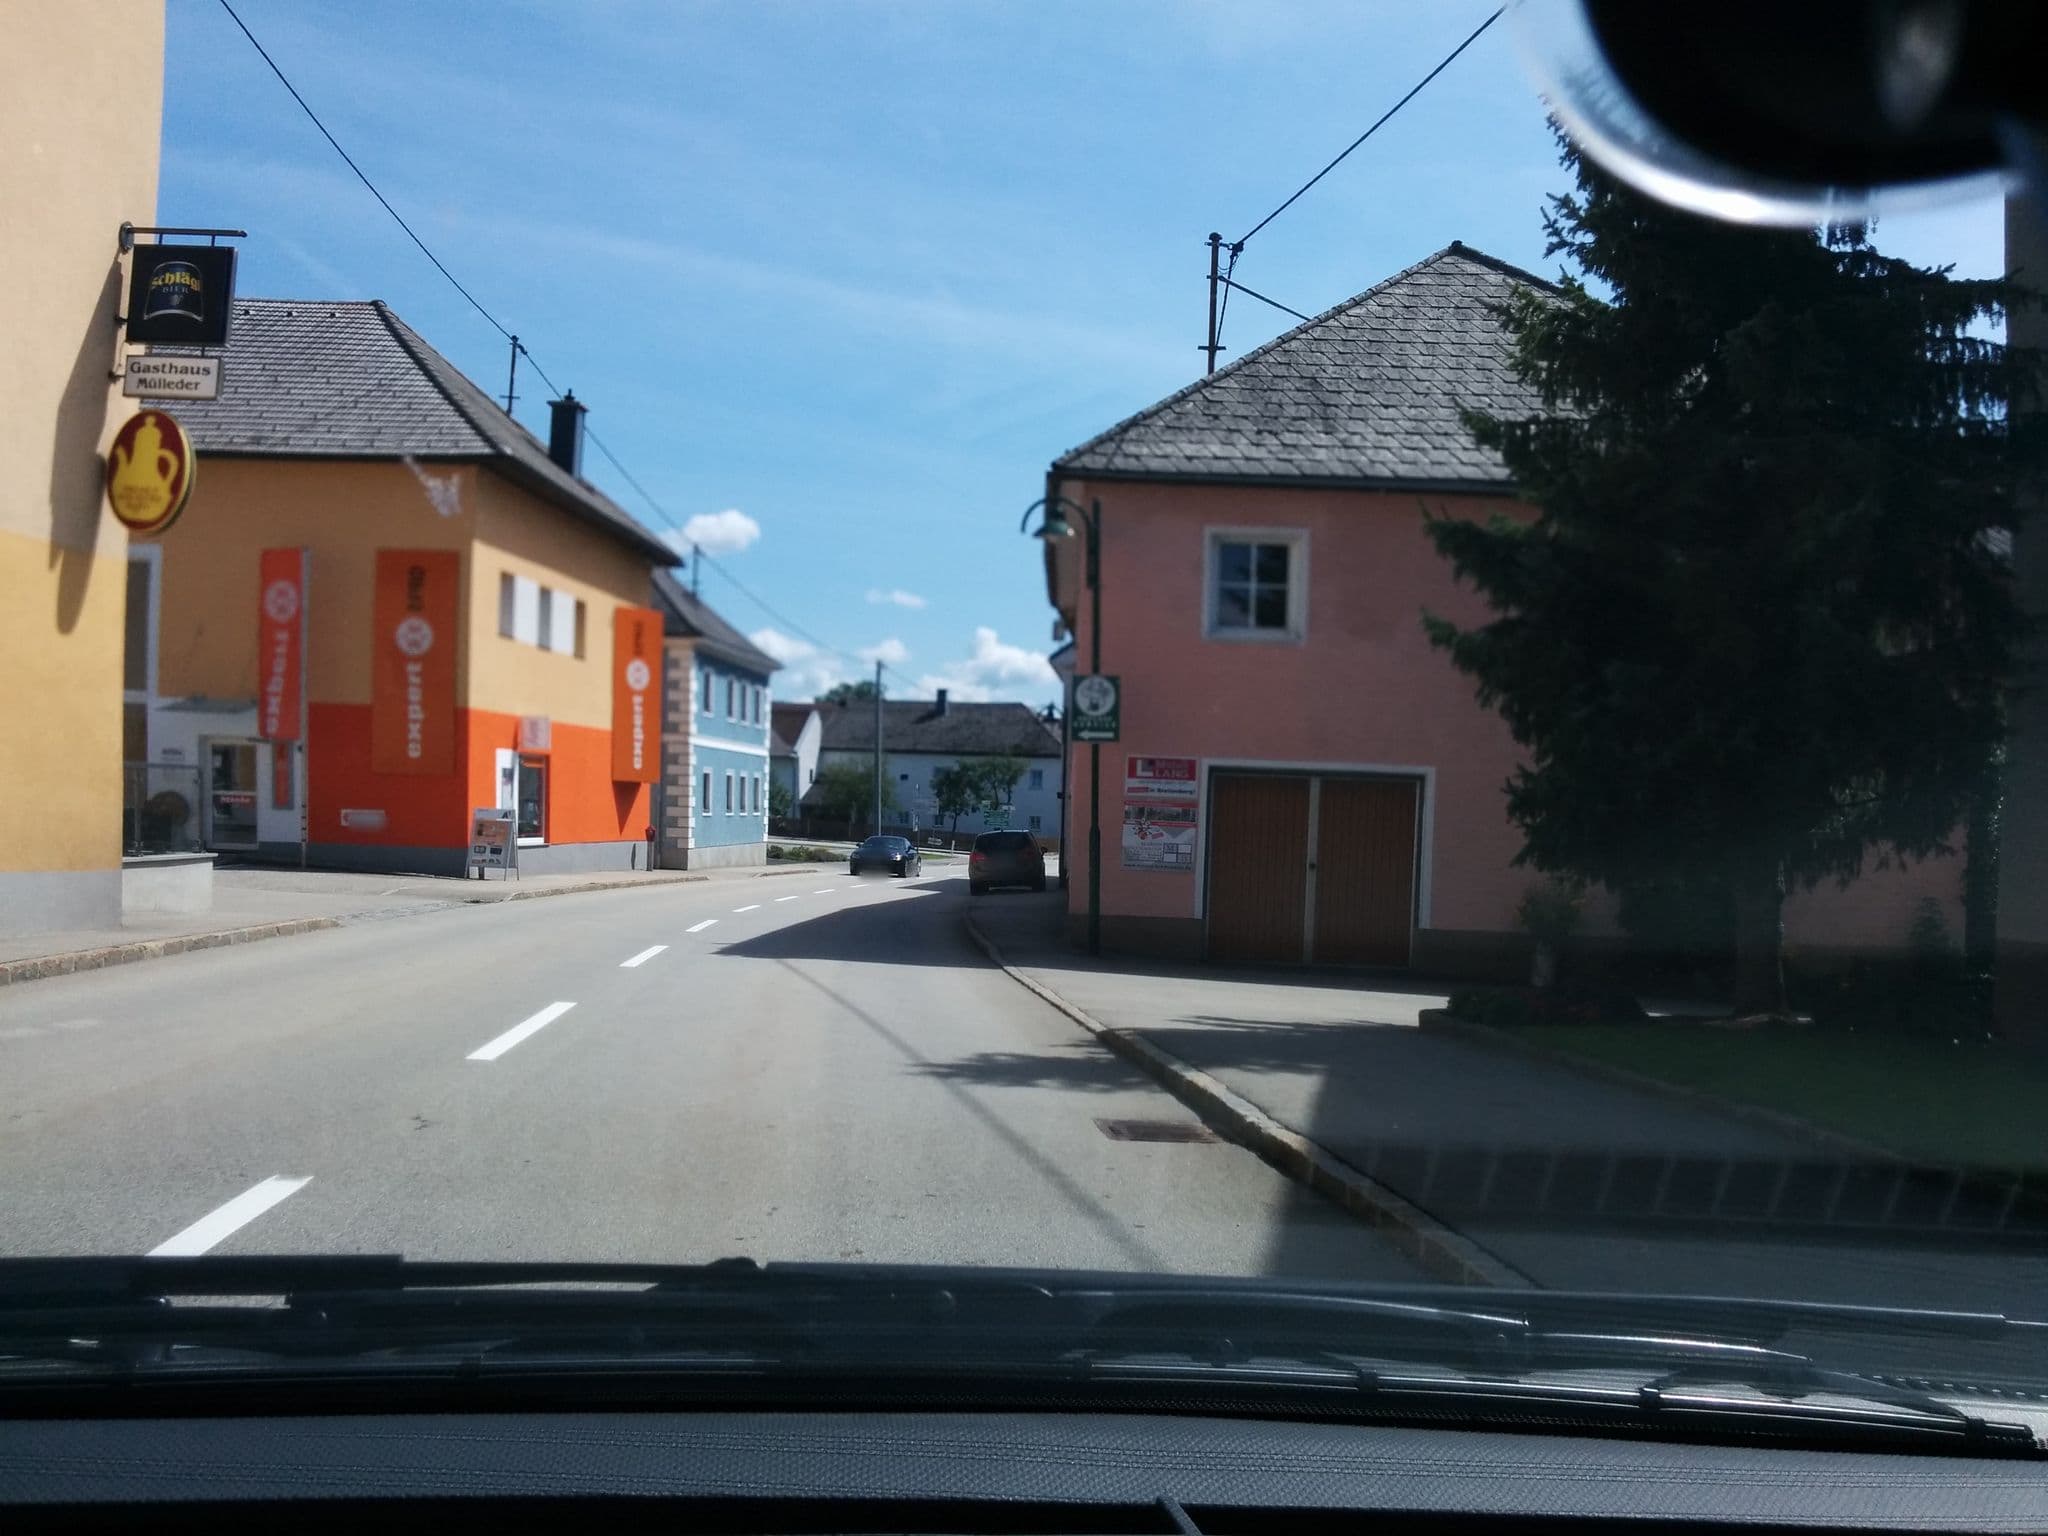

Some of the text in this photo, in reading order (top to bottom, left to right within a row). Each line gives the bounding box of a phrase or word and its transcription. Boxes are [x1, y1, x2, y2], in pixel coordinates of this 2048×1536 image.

[130, 361, 211, 376] Gasthaus
[136, 377, 201, 390] Mülleder
[407, 662, 424, 759] expert
[631, 694, 644, 769] expert
